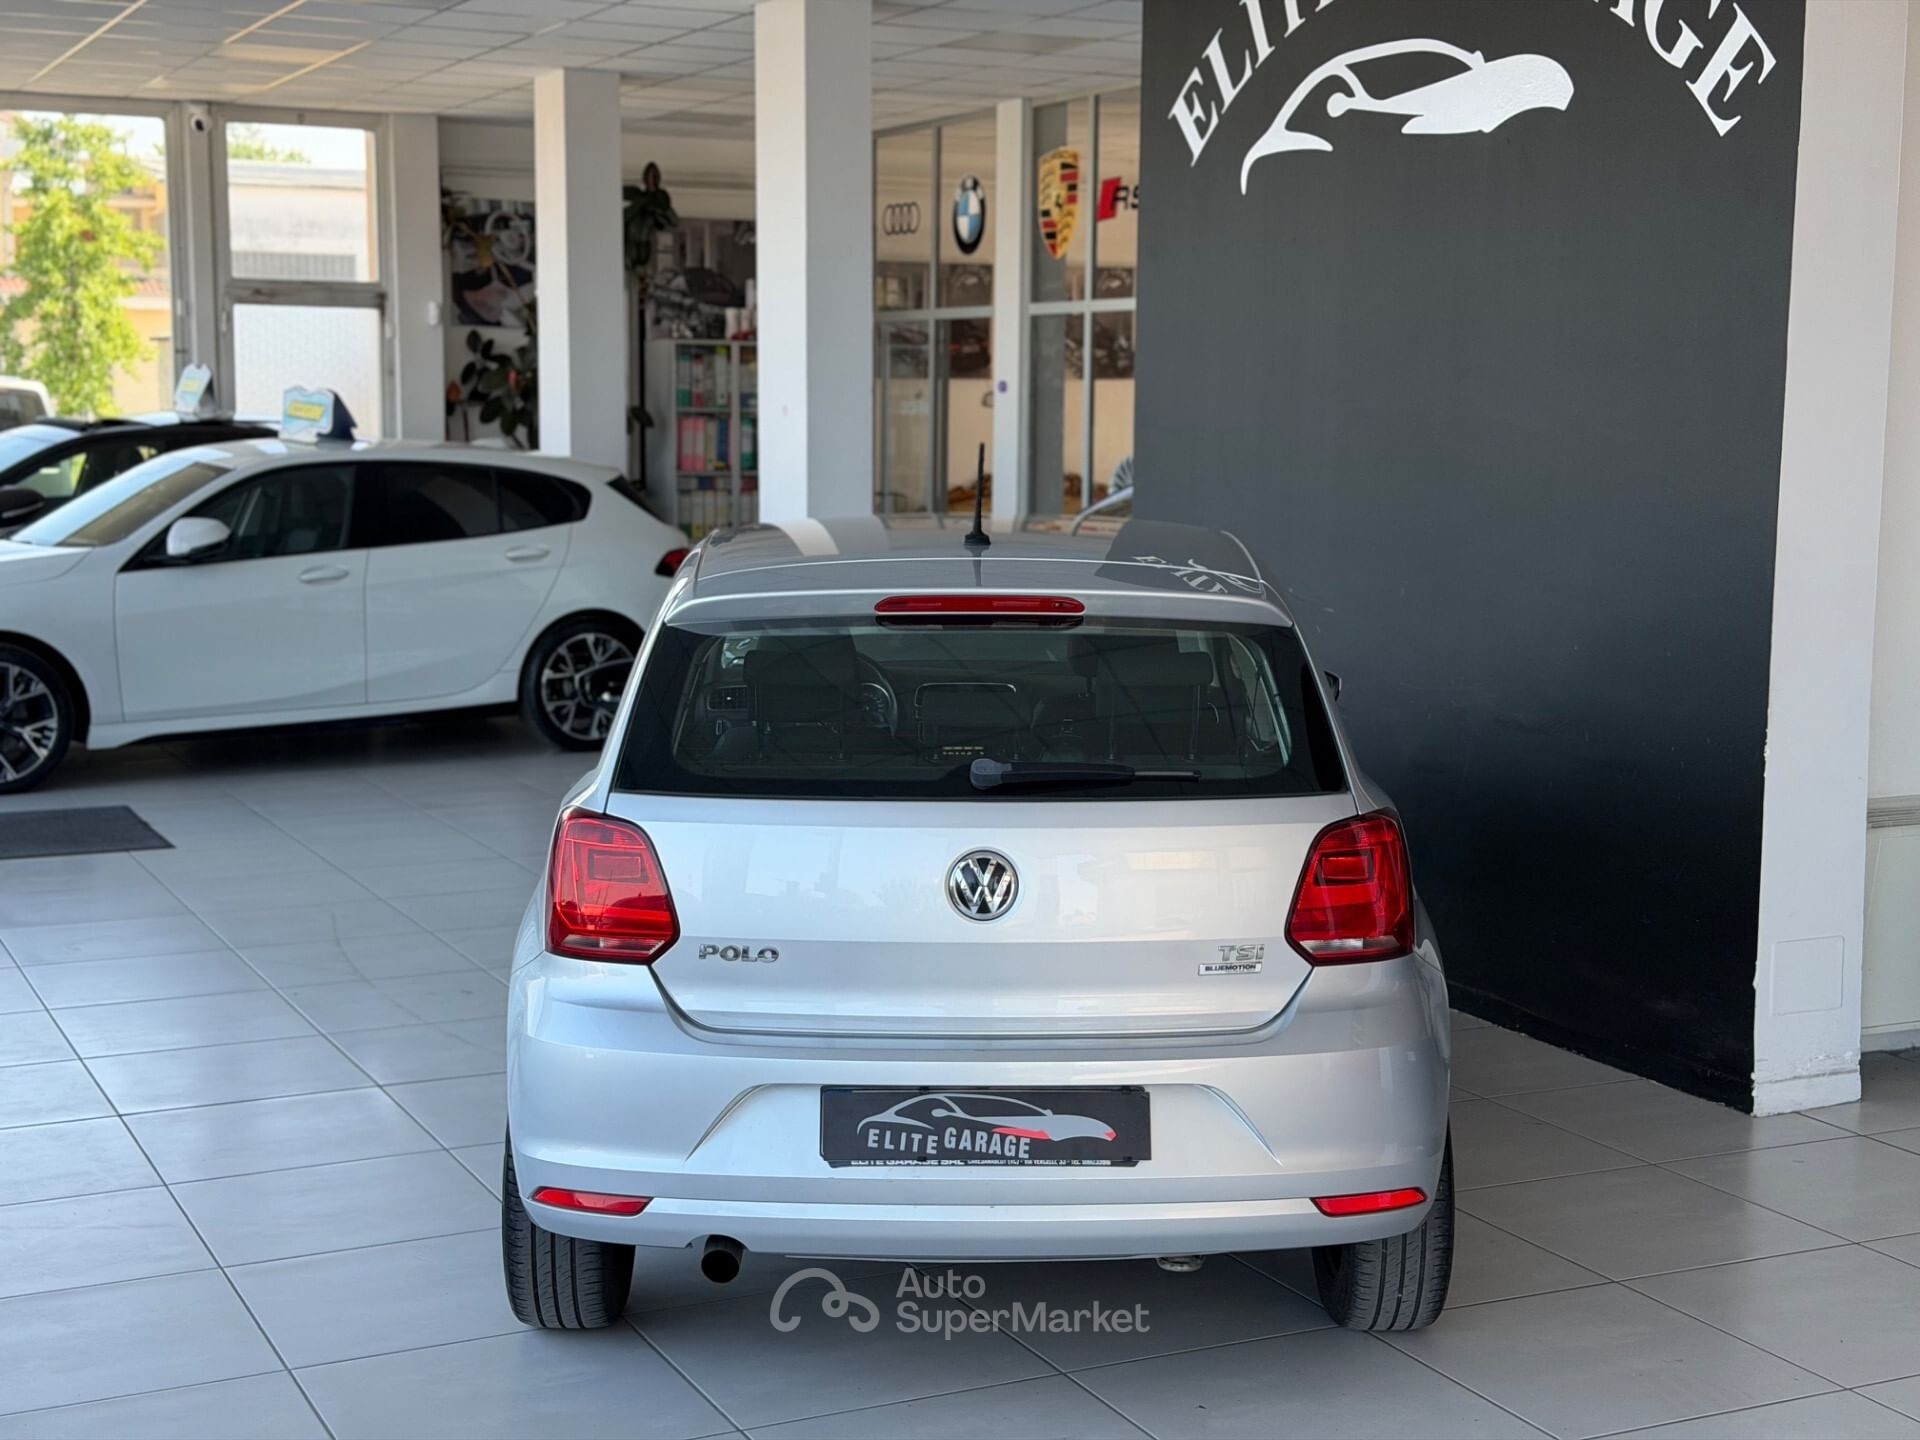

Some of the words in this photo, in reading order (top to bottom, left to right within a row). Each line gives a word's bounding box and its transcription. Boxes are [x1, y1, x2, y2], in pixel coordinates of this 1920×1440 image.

[1168, 0, 1336, 167] ELI
[698, 943, 780, 964] POLO
[1204, 963, 1257, 972] BLUEMOTION
[866, 1128, 939, 1155] ELITE
[944, 1126, 1032, 1159] GARAGE
